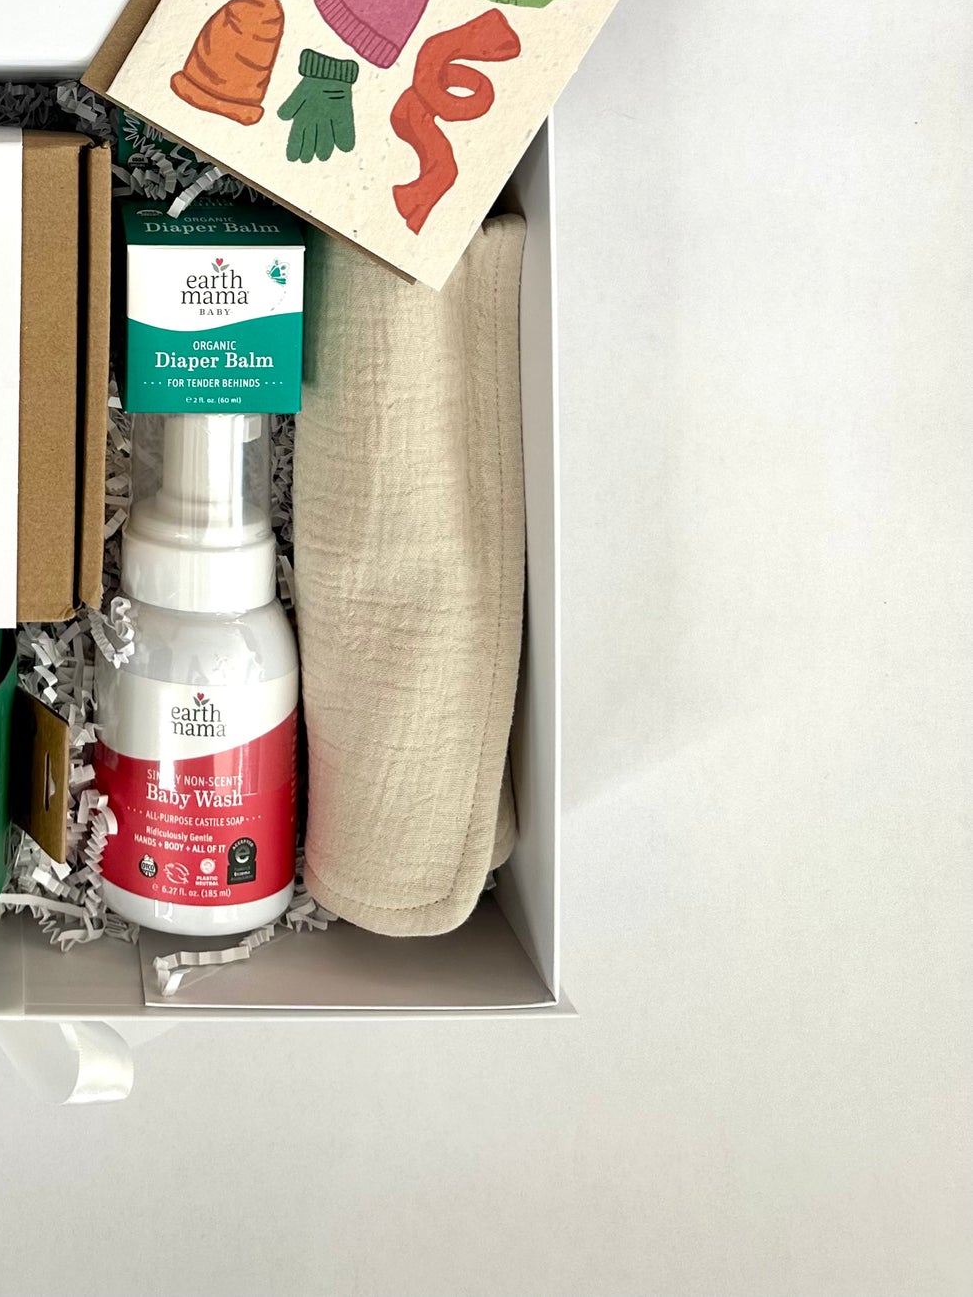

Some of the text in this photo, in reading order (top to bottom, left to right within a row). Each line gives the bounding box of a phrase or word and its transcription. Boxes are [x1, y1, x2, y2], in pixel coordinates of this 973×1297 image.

[144, 222, 281, 235] Diaper Balm
[186, 269, 244, 289] earth
[180, 290, 250, 305] mama
[198, 308, 232, 316] BABY
[192, 340, 237, 351] ORGANIC
[154, 352, 275, 371] Diaper Balm
[167, 378, 261, 388] FOR TENDER BEHINDS
[217, 396, 230, 404] (60
[230, 396, 242, 404] ml)
[171, 703, 222, 722] earth
[183, 775, 244, 788] NON-SCENTS
[145, 782, 244, 810] Baby Wash
[145, 810, 245, 827] ALL-PURPOSE CASTILE SOAP
[145, 825, 214, 842] Ridiculously Gentle
[134, 833, 157, 847] HANDS
[164, 840, 185, 852] BODY
[191, 844, 206, 853] ALL
[206, 844, 217, 853] OF
[218, 844, 227, 853] IT
[161, 885, 178, 896] 6.27
[201, 888, 218, 899] (185
